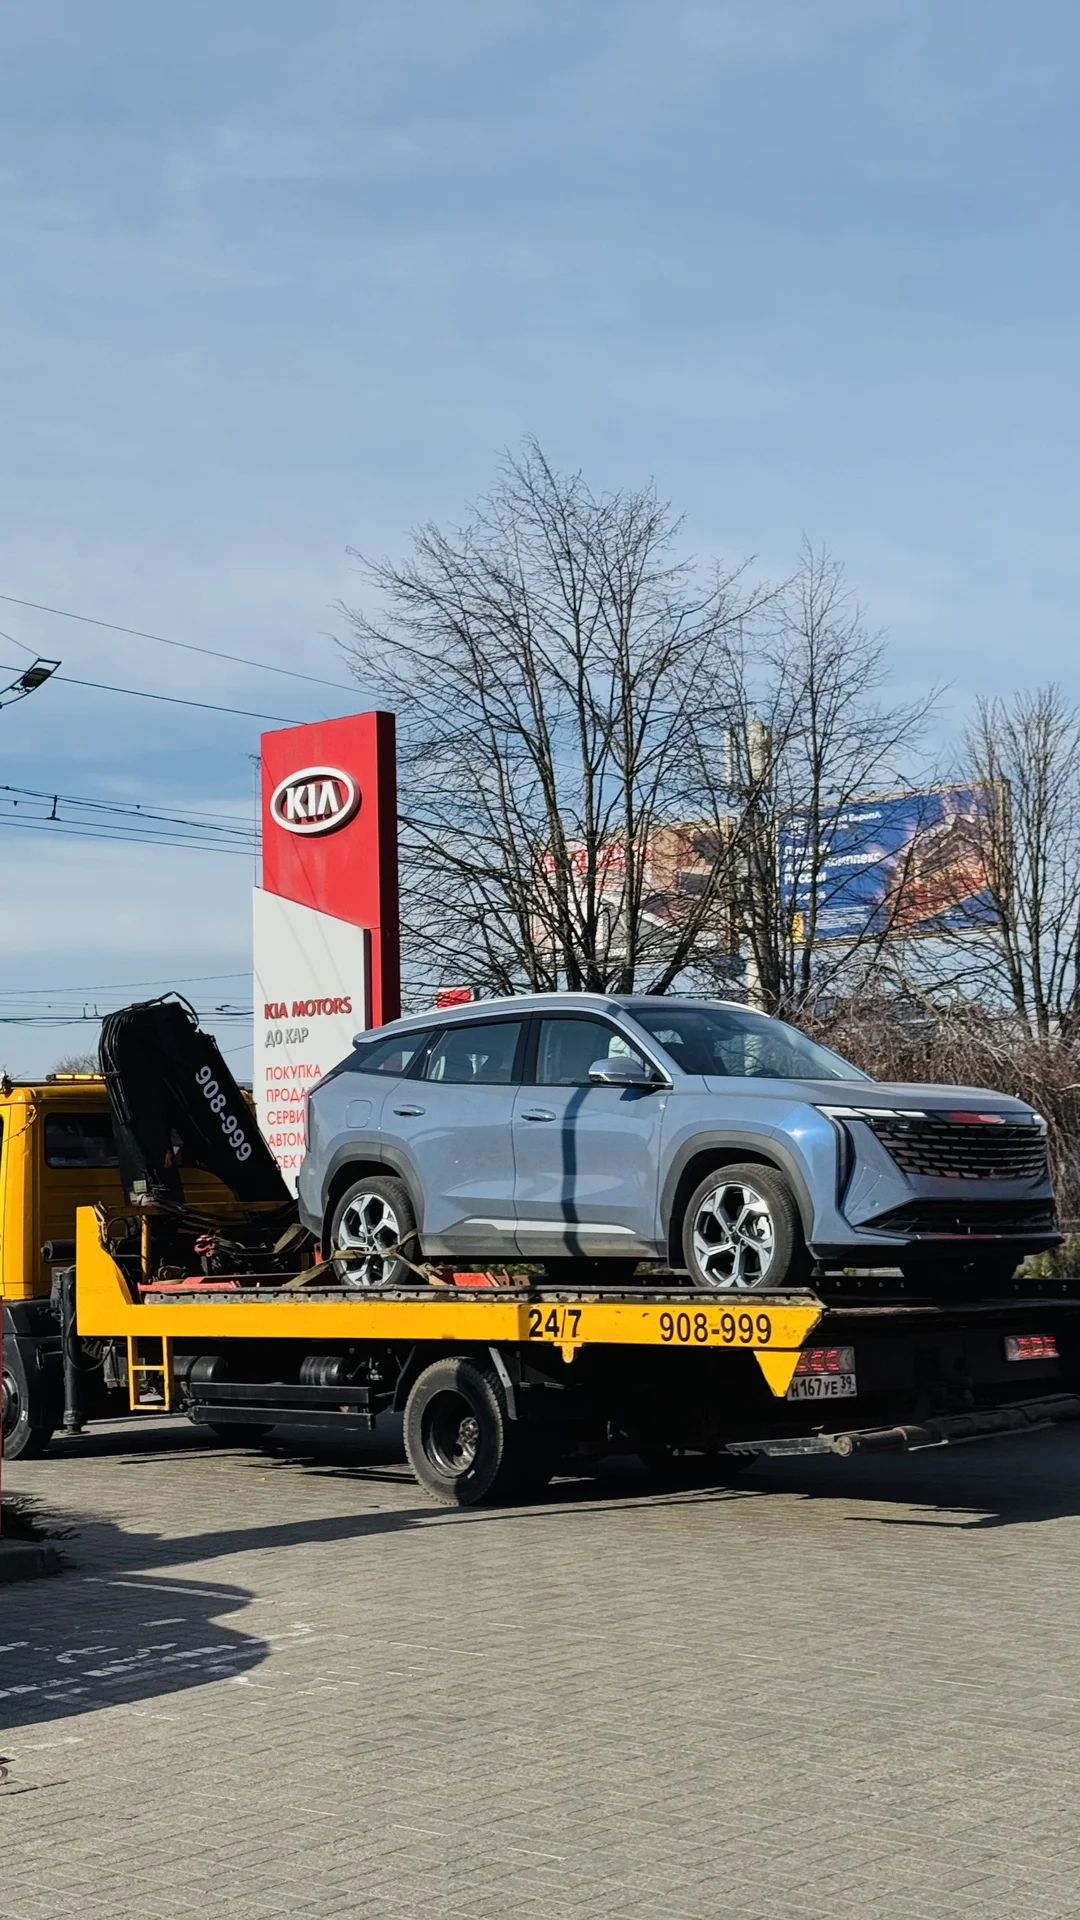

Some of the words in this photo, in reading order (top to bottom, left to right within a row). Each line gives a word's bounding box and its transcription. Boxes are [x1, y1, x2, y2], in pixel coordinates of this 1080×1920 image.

[286, 780, 340, 820] KIA
[264, 1002, 288, 1019] KIA
[292, 997, 352, 1017] MOTORS
[265, 1030, 283, 1048] ДО
[285, 1027, 309, 1044] КАР
[265, 1064, 322, 1081] ПОКУПКА
[195, 1066, 252, 1161] 908-999
[528, 1309, 582, 1338] 24/7
[659, 1312, 772, 1345] 908-999
